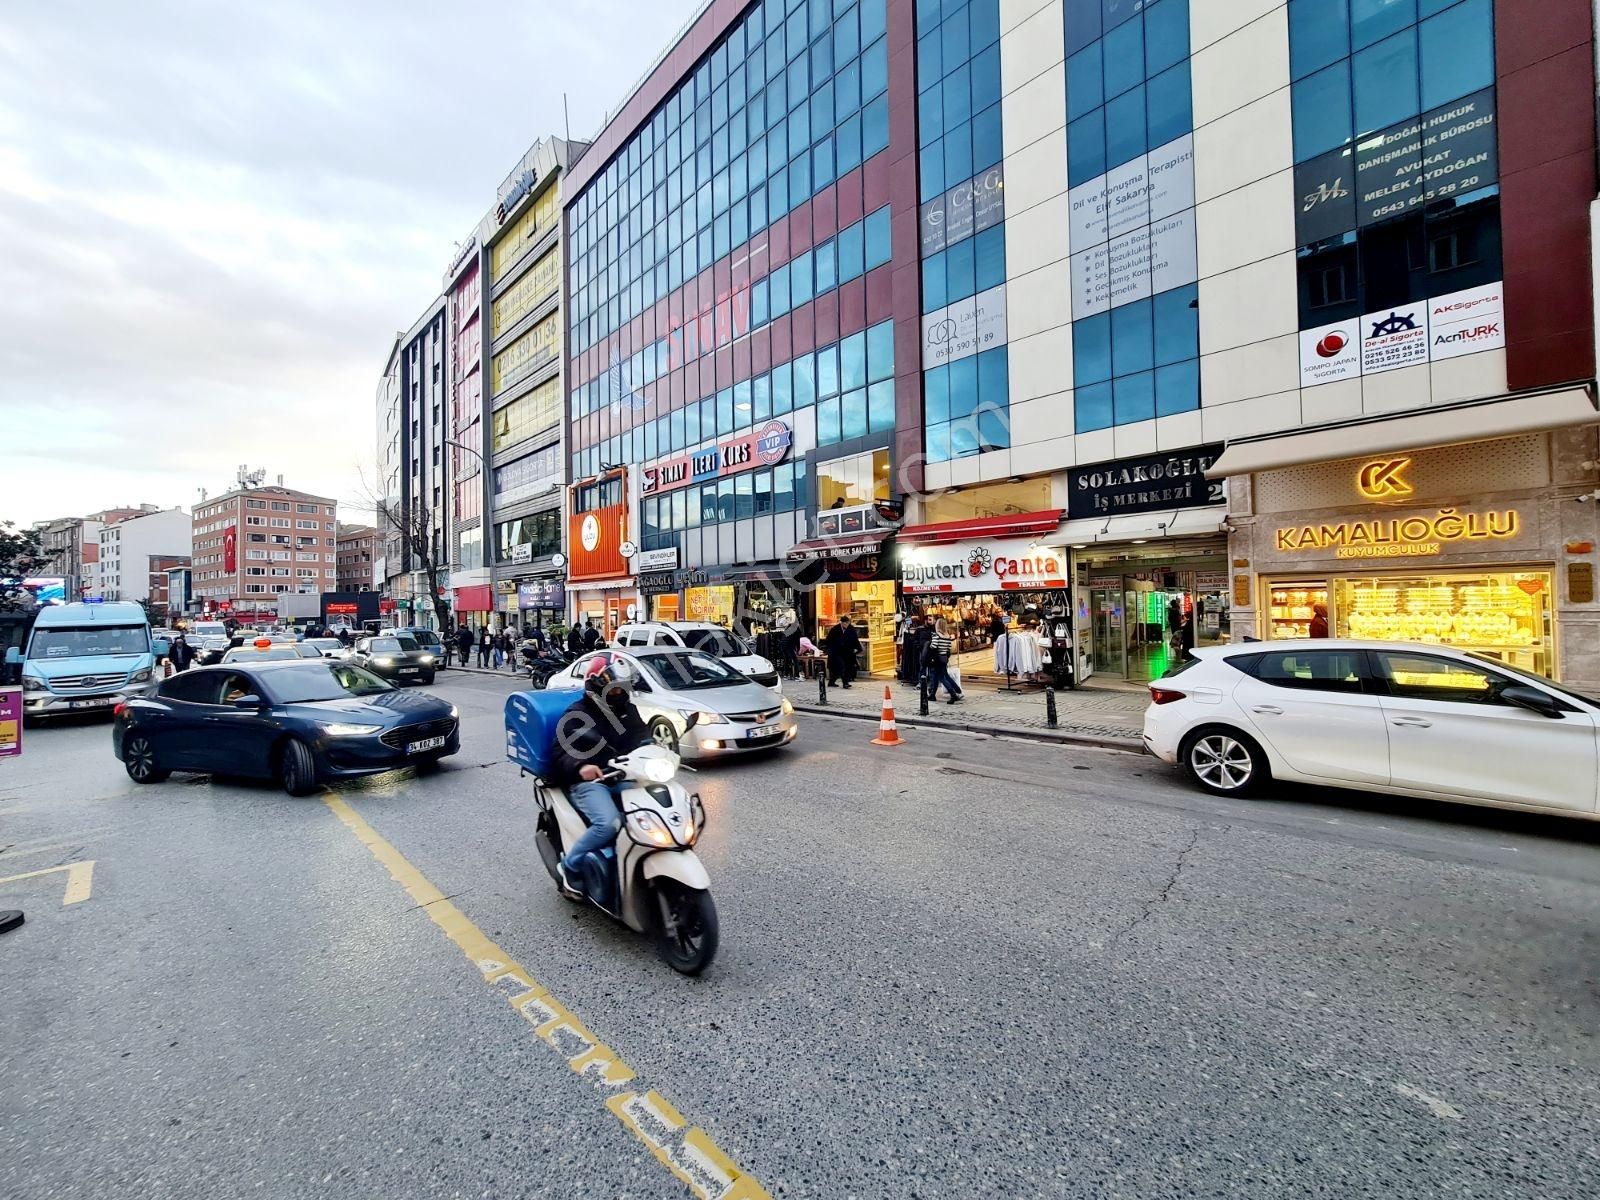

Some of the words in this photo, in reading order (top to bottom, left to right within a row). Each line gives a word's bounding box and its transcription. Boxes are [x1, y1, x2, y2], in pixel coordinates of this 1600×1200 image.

[1430, 103, 1475, 126] HUKUK
[1358, 136, 1438, 172] DANIŞMANLIK
[1440, 114, 1493, 140] BÜROSU
[1395, 150, 1452, 176] AVUKAT
[1073, 201, 1084, 211] Dil
[1087, 195, 1098, 204] ve
[1100, 174, 1143, 200] Konuşma
[1149, 149, 1193, 176] Terapisti
[1364, 180, 1410, 202] MELEK
[1414, 152, 1488, 185] AYDOĞAN
[1116, 182, 1155, 206] Sakarya
[1372, 200, 1405, 218] 0543
[1408, 190, 1434, 206] 645
[1438, 184, 1456, 196] 28
[1460, 176, 1478, 189] 20
[1095, 260, 1104, 270] Dil
[1095, 272, 1108, 280] Ses
[1132, 261, 1168, 278] Konuşma
[984, 333, 994, 342] 89
[1390, 330, 1424, 344] Sigorta
[1304, 362, 1331, 372] SOMPO
[1332, 357, 1357, 368] JAPAN
[1364, 350, 1384, 359] 0216
[765, 436, 780, 448] VIP
[720, 442, 749, 467] KURS
[1078, 456, 1213, 490] SOLAKOĞLU
[1094, 494, 1108, 512] İŞ
[1114, 482, 1192, 507] MERKEZİ
[1278, 508, 1516, 549] KAMALIOĞLU
[852, 546, 876, 555] SALONU
[1338, 544, 1440, 557] KUYUMCULUK
[905, 560, 964, 584] Bijuteri
[994, 555, 1056, 580] Çanta
